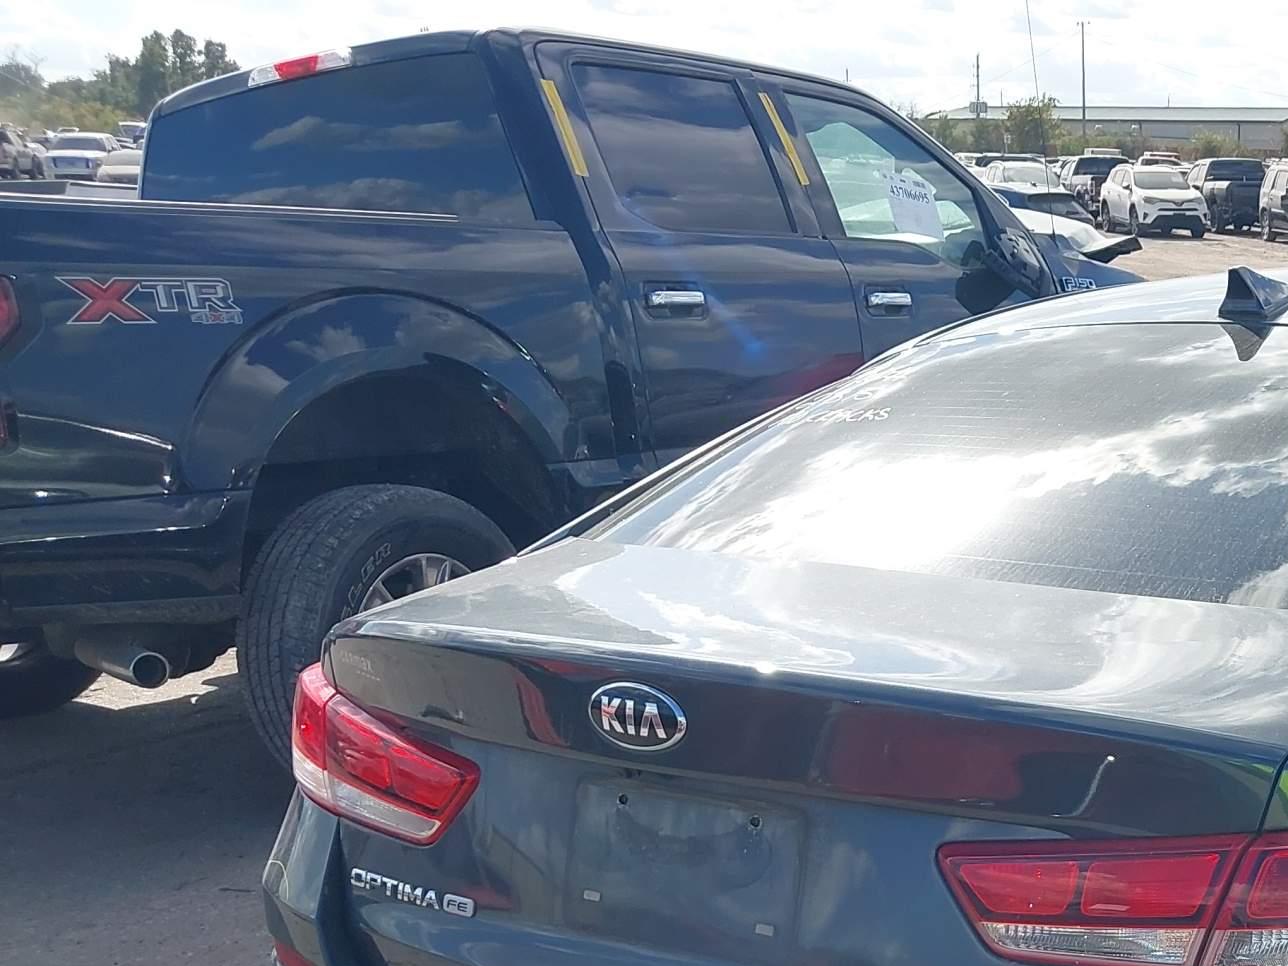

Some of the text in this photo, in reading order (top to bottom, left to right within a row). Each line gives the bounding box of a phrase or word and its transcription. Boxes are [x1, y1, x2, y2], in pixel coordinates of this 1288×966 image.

[889, 184, 930, 204] 43706695
[55, 276, 243, 324] XTR
[600, 695, 668, 739] KIA
[350, 867, 468, 912] OPTIMA FE
